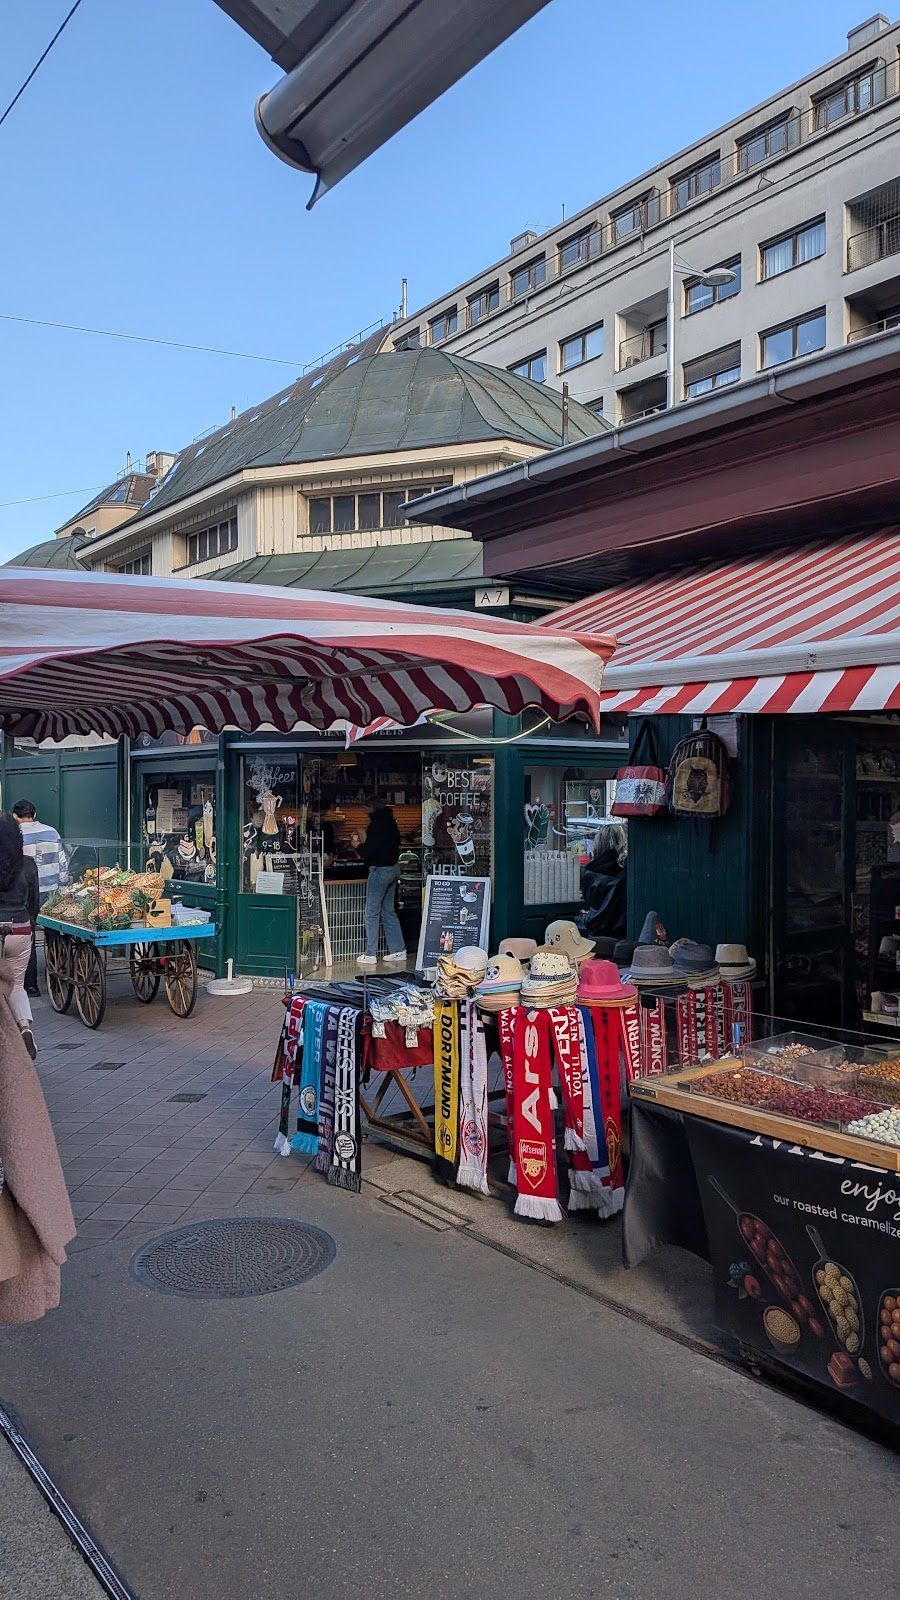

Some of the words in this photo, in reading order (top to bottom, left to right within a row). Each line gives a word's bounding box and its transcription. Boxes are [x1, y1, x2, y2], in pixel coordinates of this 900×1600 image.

[480, 591, 491, 604] A
[496, 590, 503, 603] 7
[447, 771, 477, 788] BEST
[439, 792, 481, 807] COFFEE
[262, 840, 281, 851] 9-18
[432, 863, 466, 877] HERE
[500, 1009, 512, 1043] WALK
[440, 1014, 453, 1120] DORTMUND
[572, 1053, 583, 1097] YOU'LL
[336, 1088, 354, 1118] SK
[773, 1194, 790, 1206] our
[792, 1200, 838, 1220] roasted
